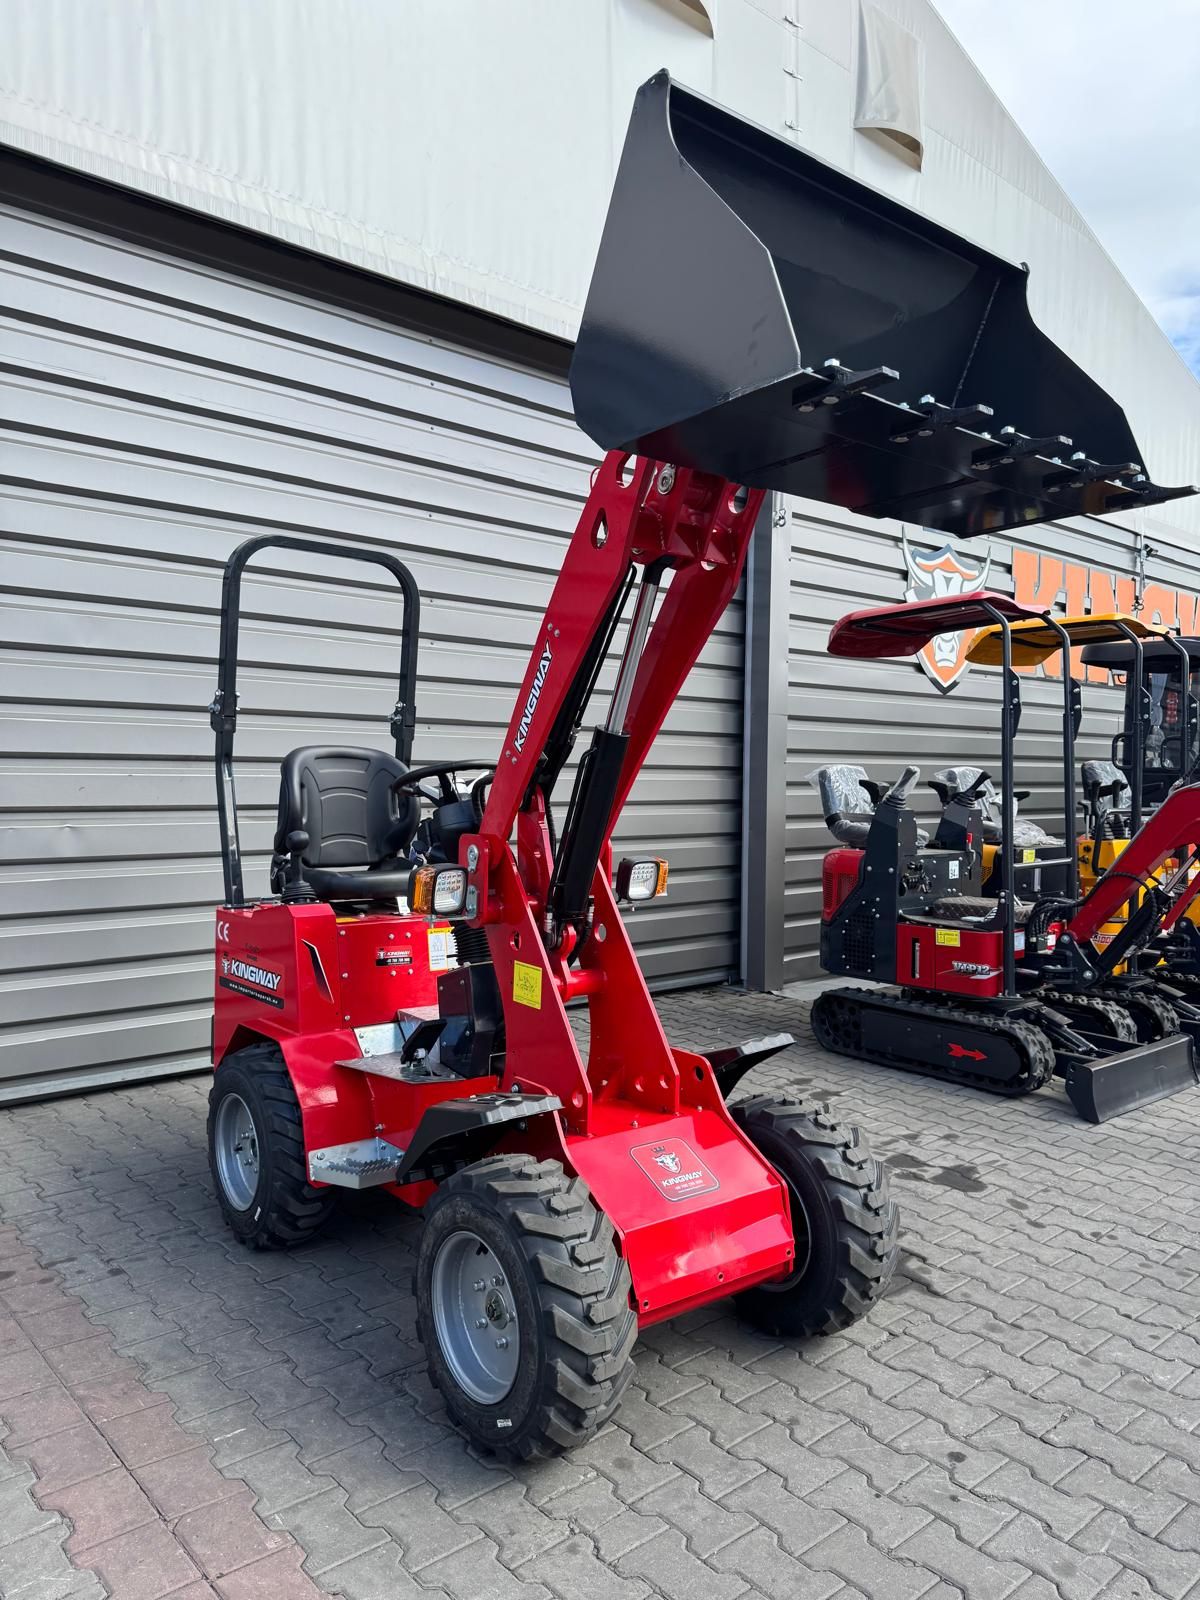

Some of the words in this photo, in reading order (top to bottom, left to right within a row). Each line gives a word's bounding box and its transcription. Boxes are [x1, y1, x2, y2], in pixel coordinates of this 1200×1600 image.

[513, 639, 553, 753] KINGWAY
[217, 920, 230, 943] CE
[230, 959, 281, 990] KINGWAY
[662, 1171, 703, 1186] KINGWAY
